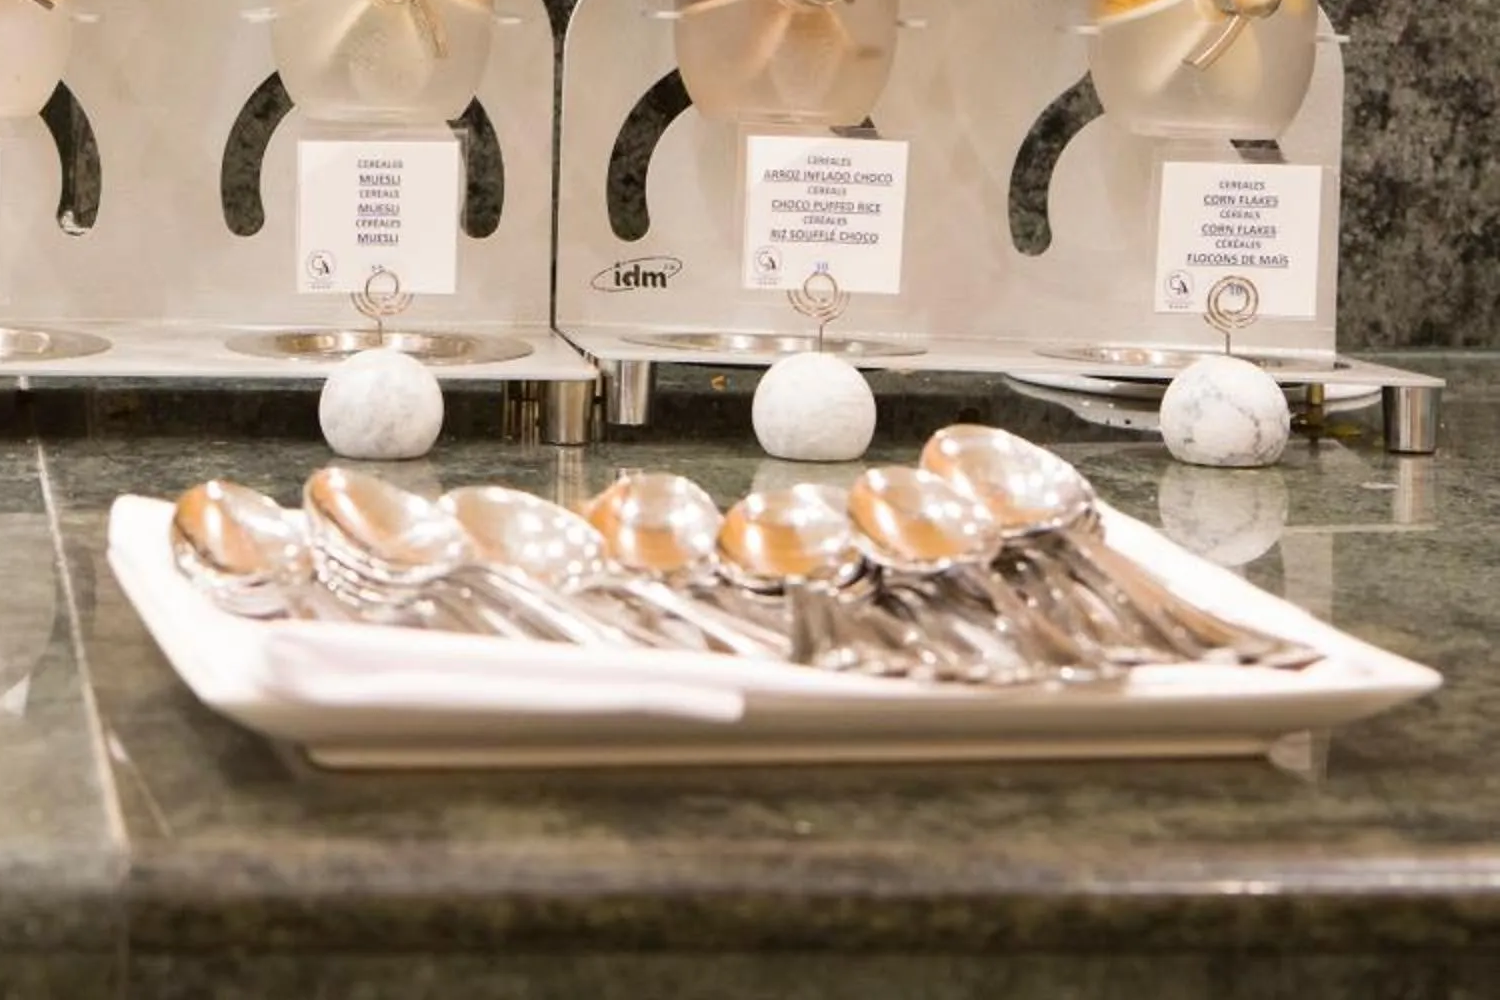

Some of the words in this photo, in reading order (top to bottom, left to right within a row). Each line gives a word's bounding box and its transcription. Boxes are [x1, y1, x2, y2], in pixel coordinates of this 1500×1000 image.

[357, 159, 404, 169] CEREALES
[359, 174, 402, 186] MUESLI
[763, 169, 801, 182] ARROZ
[803, 170, 851, 184] INFLADO
[853, 172, 893, 186] CHOCO
[1219, 180, 1265, 190] CEREALES
[359, 189, 400, 199] CEREALS
[771, 199, 810, 212] CHOCO
[813, 200, 855, 213] PUFFED
[857, 202, 881, 214] RICE
[1203, 194, 1235, 207] CORN
[1238, 196, 1279, 208] FLAKES
[357, 203, 401, 215] MUESLI
[1201, 223, 1234, 236] CORN
[1237, 225, 1277, 238] FLAKES
[357, 233, 400, 244] MUESLI
[839, 231, 879, 244] CHOCO
[1187, 253, 1238, 266] FLOCONS
[1241, 254, 1257, 266] DE
[614, 262, 667, 288] idm
